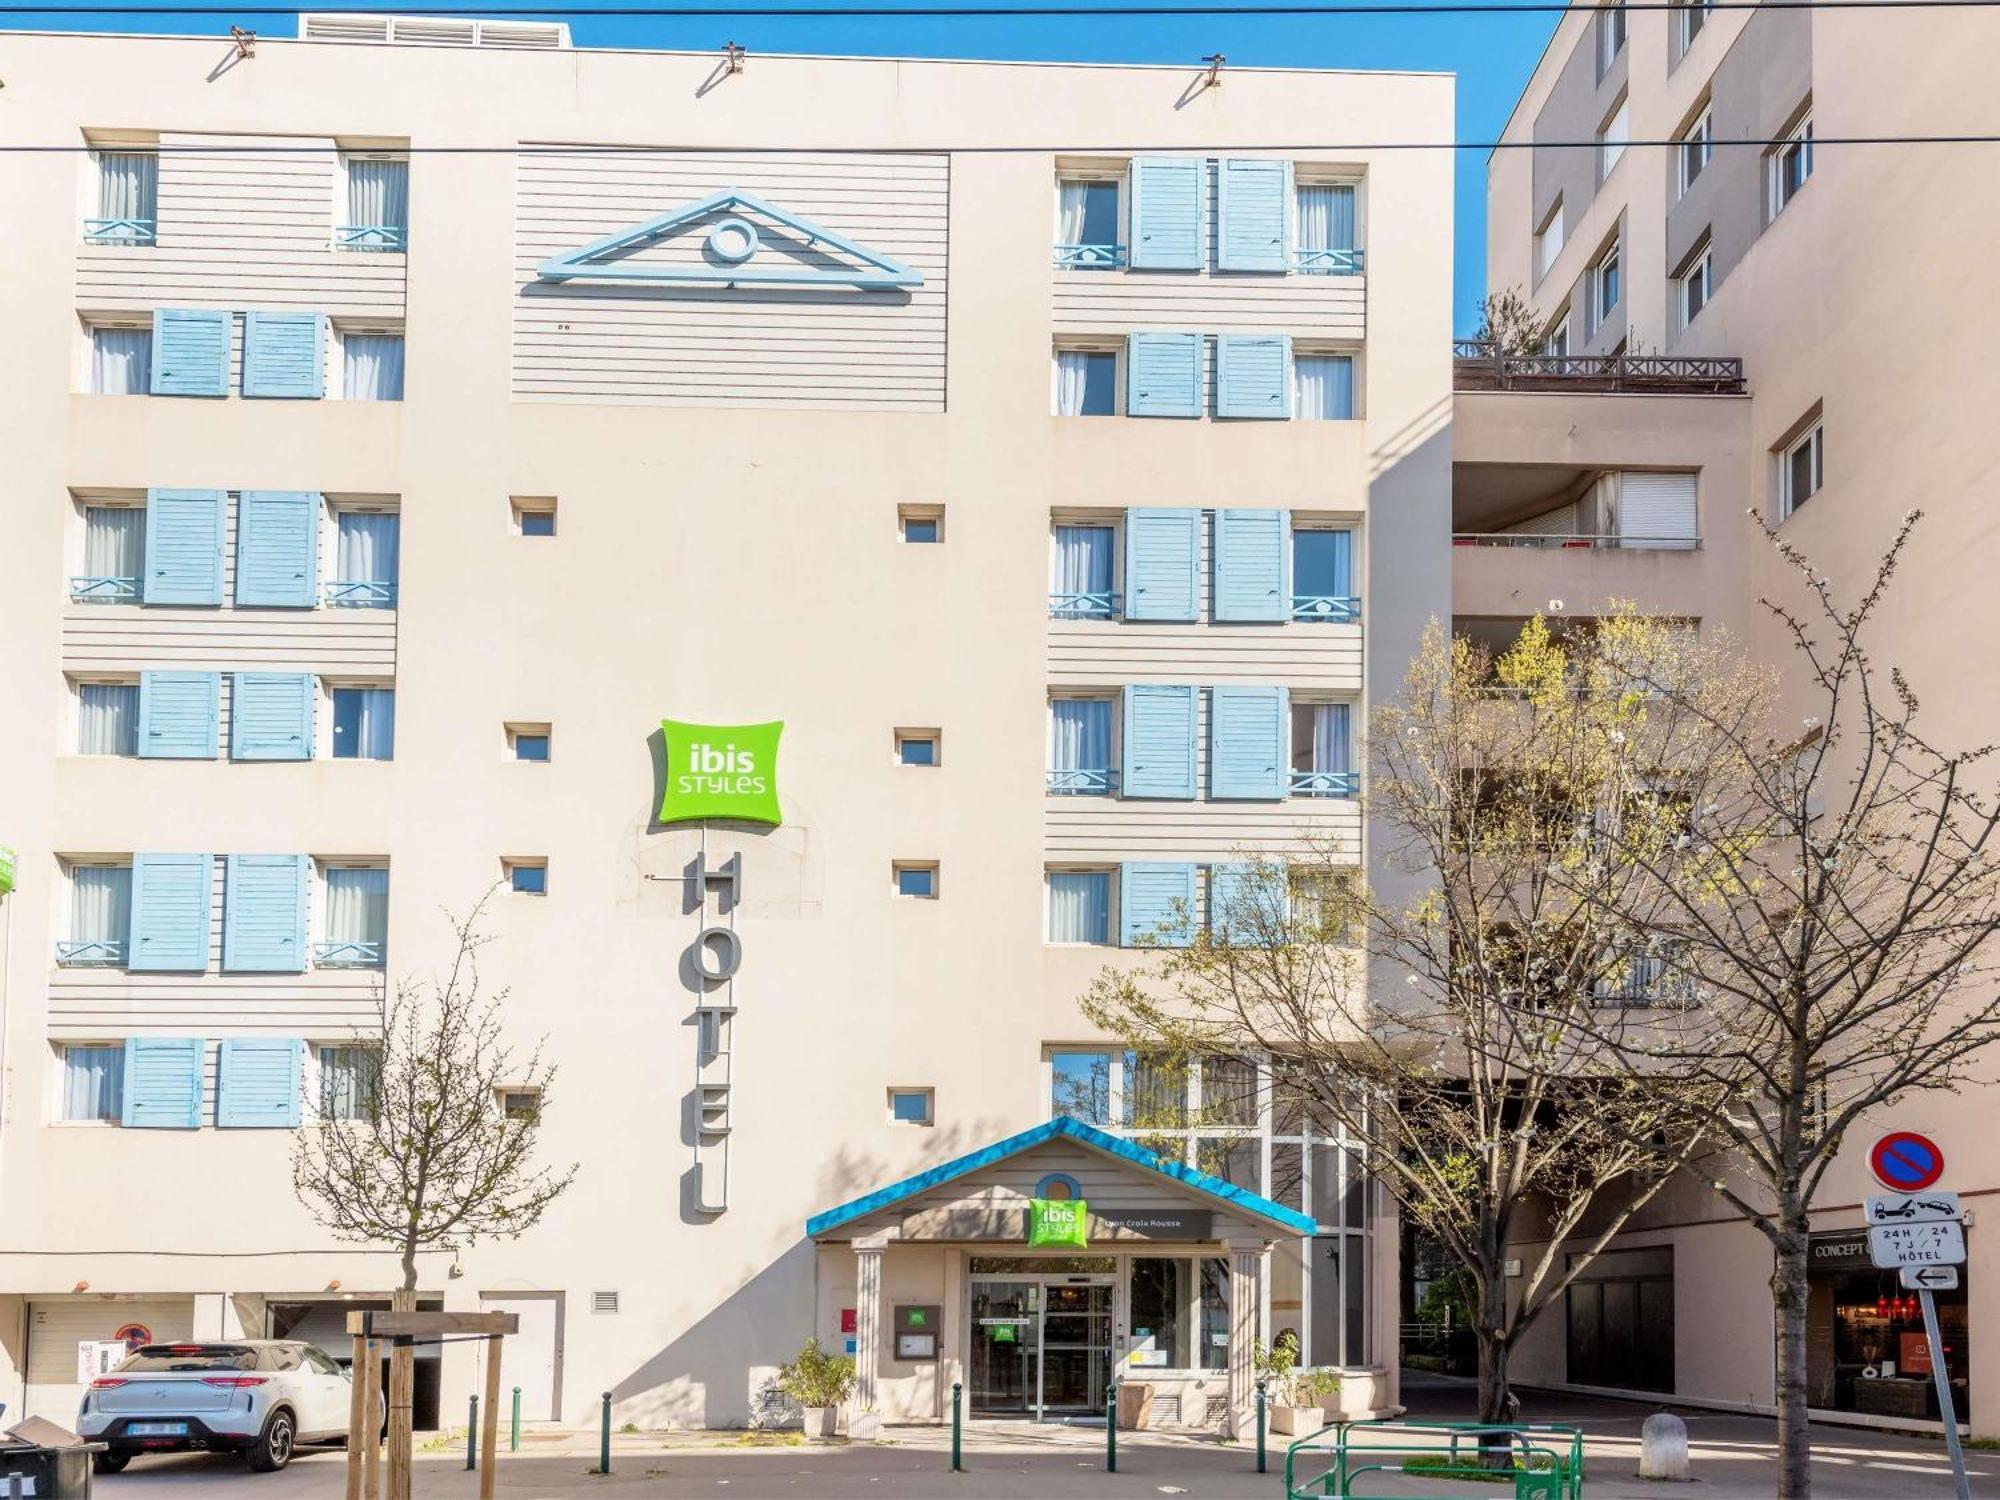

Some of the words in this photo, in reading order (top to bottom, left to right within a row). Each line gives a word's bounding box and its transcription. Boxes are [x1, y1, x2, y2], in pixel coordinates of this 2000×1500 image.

[690, 744, 755, 773] ibis
[692, 851, 741, 1213] HOTEL
[1042, 1207, 1075, 1222] ibis
[1150, 1219, 1181, 1227] Rousse
[1931, 1226, 1948, 1235] 24
[1815, 1244, 1864, 1257] CONCEPT
